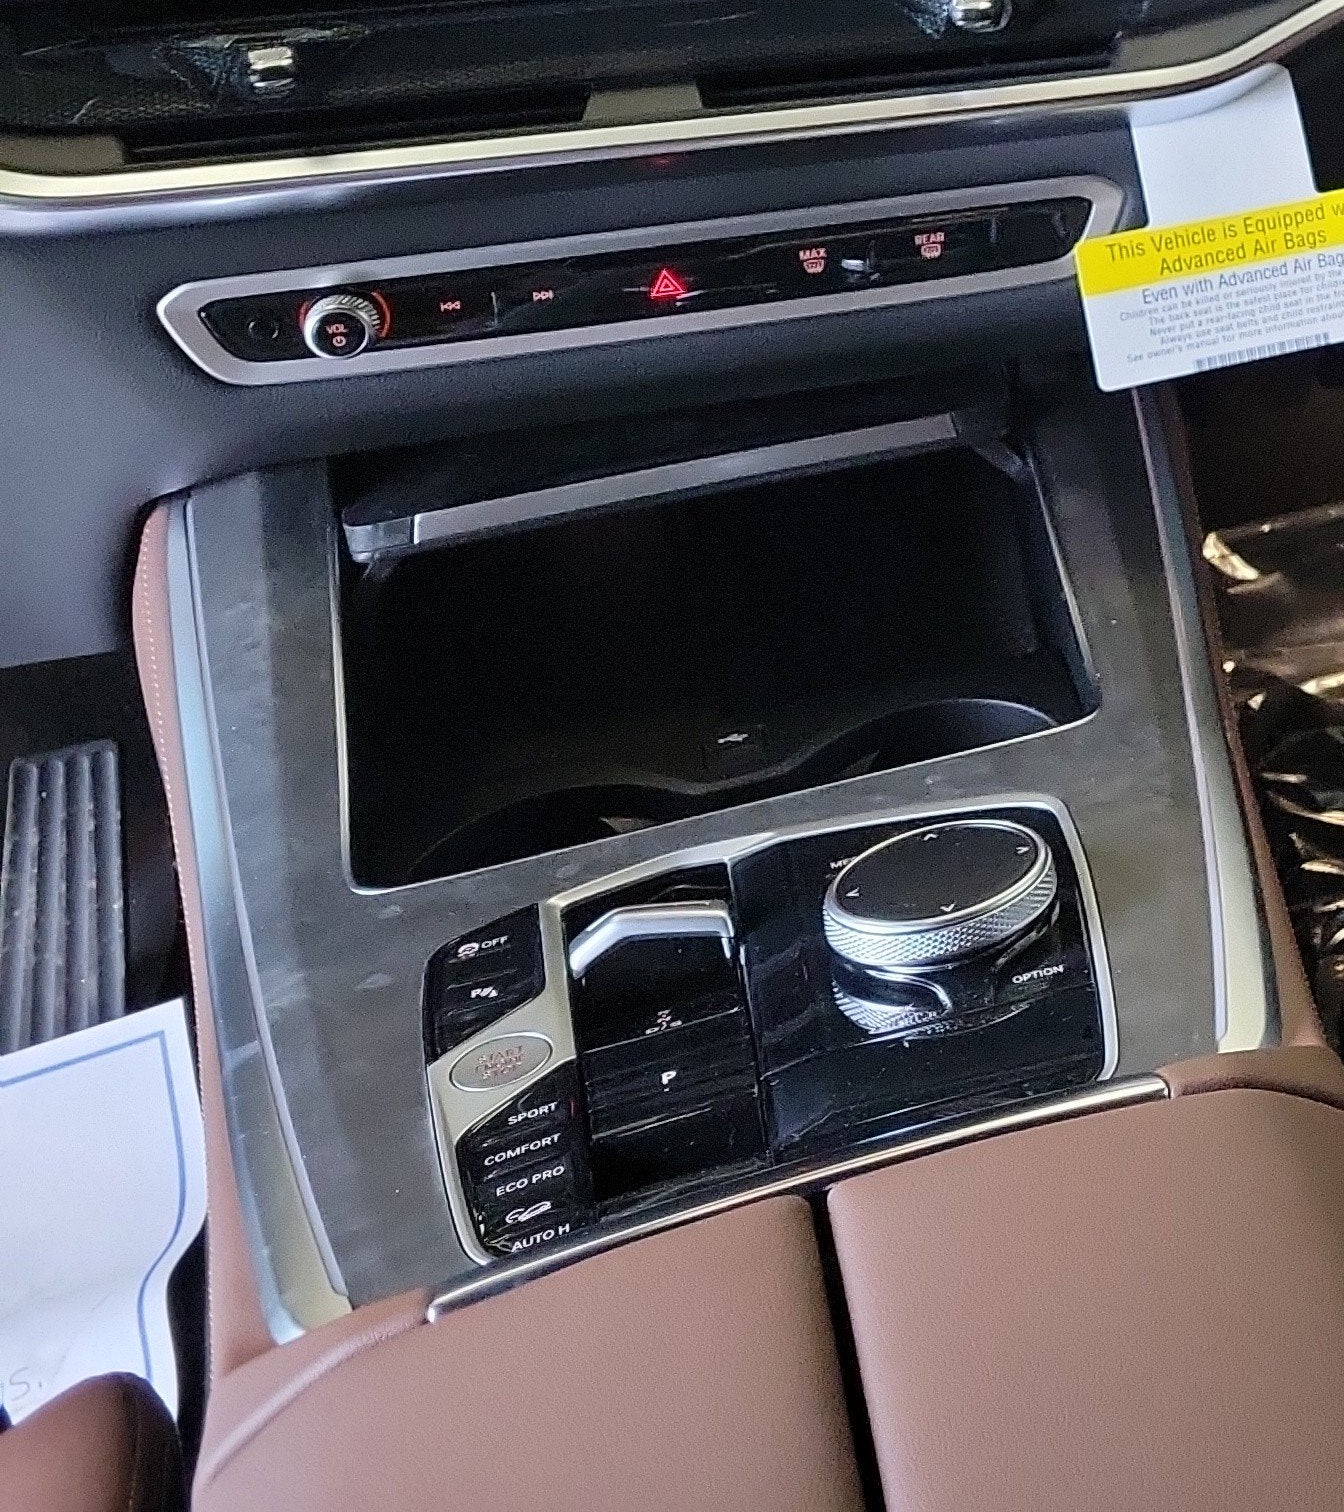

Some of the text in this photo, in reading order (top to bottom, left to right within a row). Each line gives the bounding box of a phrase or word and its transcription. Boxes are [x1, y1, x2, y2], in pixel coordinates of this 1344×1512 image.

[1106, 242, 1146, 263] This
[1150, 229, 1216, 255] Vehicle
[1222, 222, 1238, 240] is
[1243, 205, 1326, 235] Equipped
[799, 247, 827, 261] MAX
[1159, 227, 1328, 276] Advanced Air Bags
[1142, 284, 1178, 304] Even
[1182, 277, 1214, 296] with
[1217, 261, 1288, 289] Advanced
[1292, 257, 1312, 274] Air
[481, 935, 508, 948] OFF
[1011, 963, 1065, 984] OPTION
[507, 1101, 559, 1126] SPORT
[483, 1133, 562, 1167] COMFORT
[496, 1165, 565, 1197] ECO PRO
[511, 1223, 571, 1253] AUTO H
